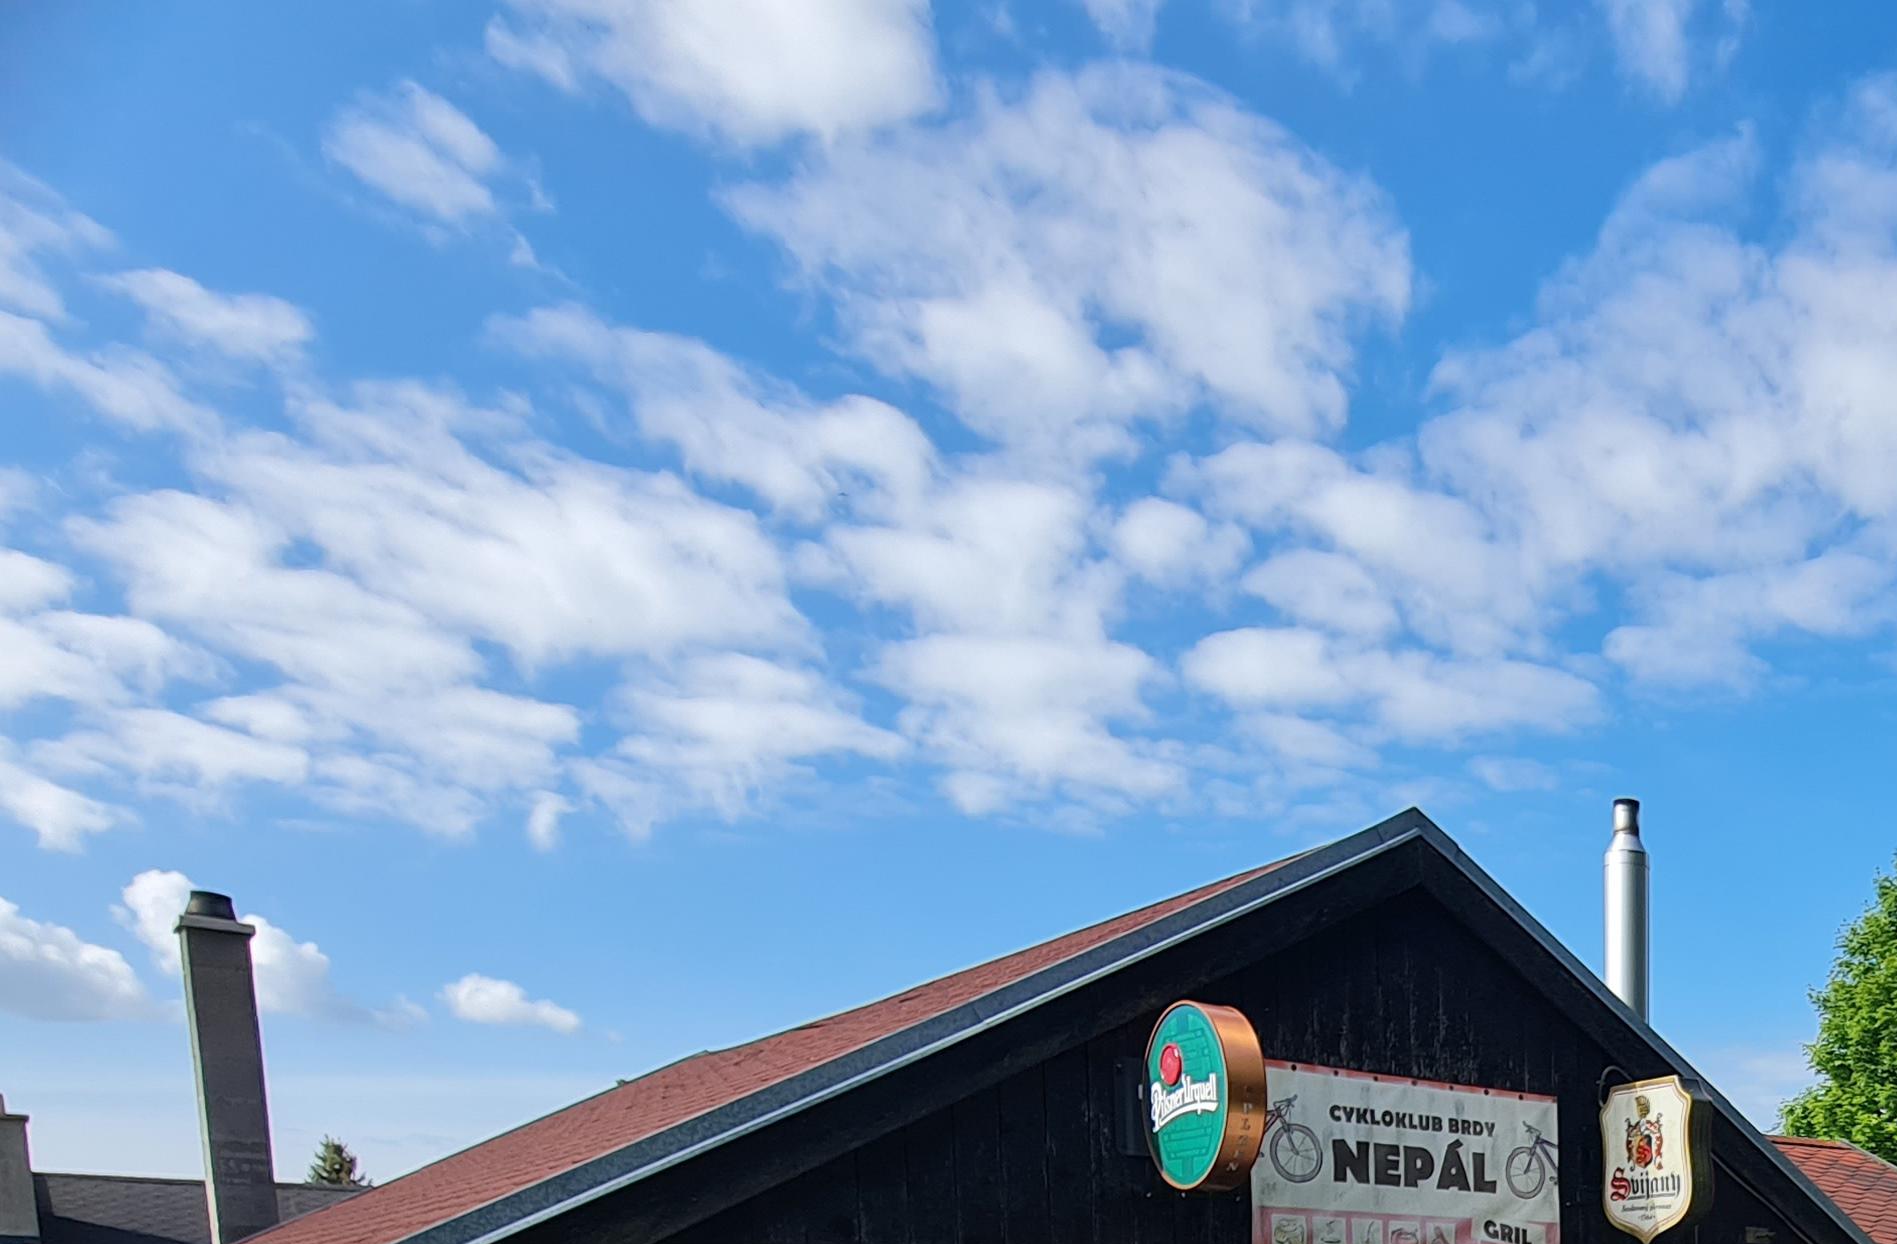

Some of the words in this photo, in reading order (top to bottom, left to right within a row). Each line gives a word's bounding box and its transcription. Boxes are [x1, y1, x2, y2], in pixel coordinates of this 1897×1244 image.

[1329, 1104, 1443, 1133] CYKLOKLUB
[1448, 1117, 1495, 1137] BRDY
[1332, 1138, 1498, 1194] NEPÁL
[1610, 1167, 1680, 1201] Svijany
